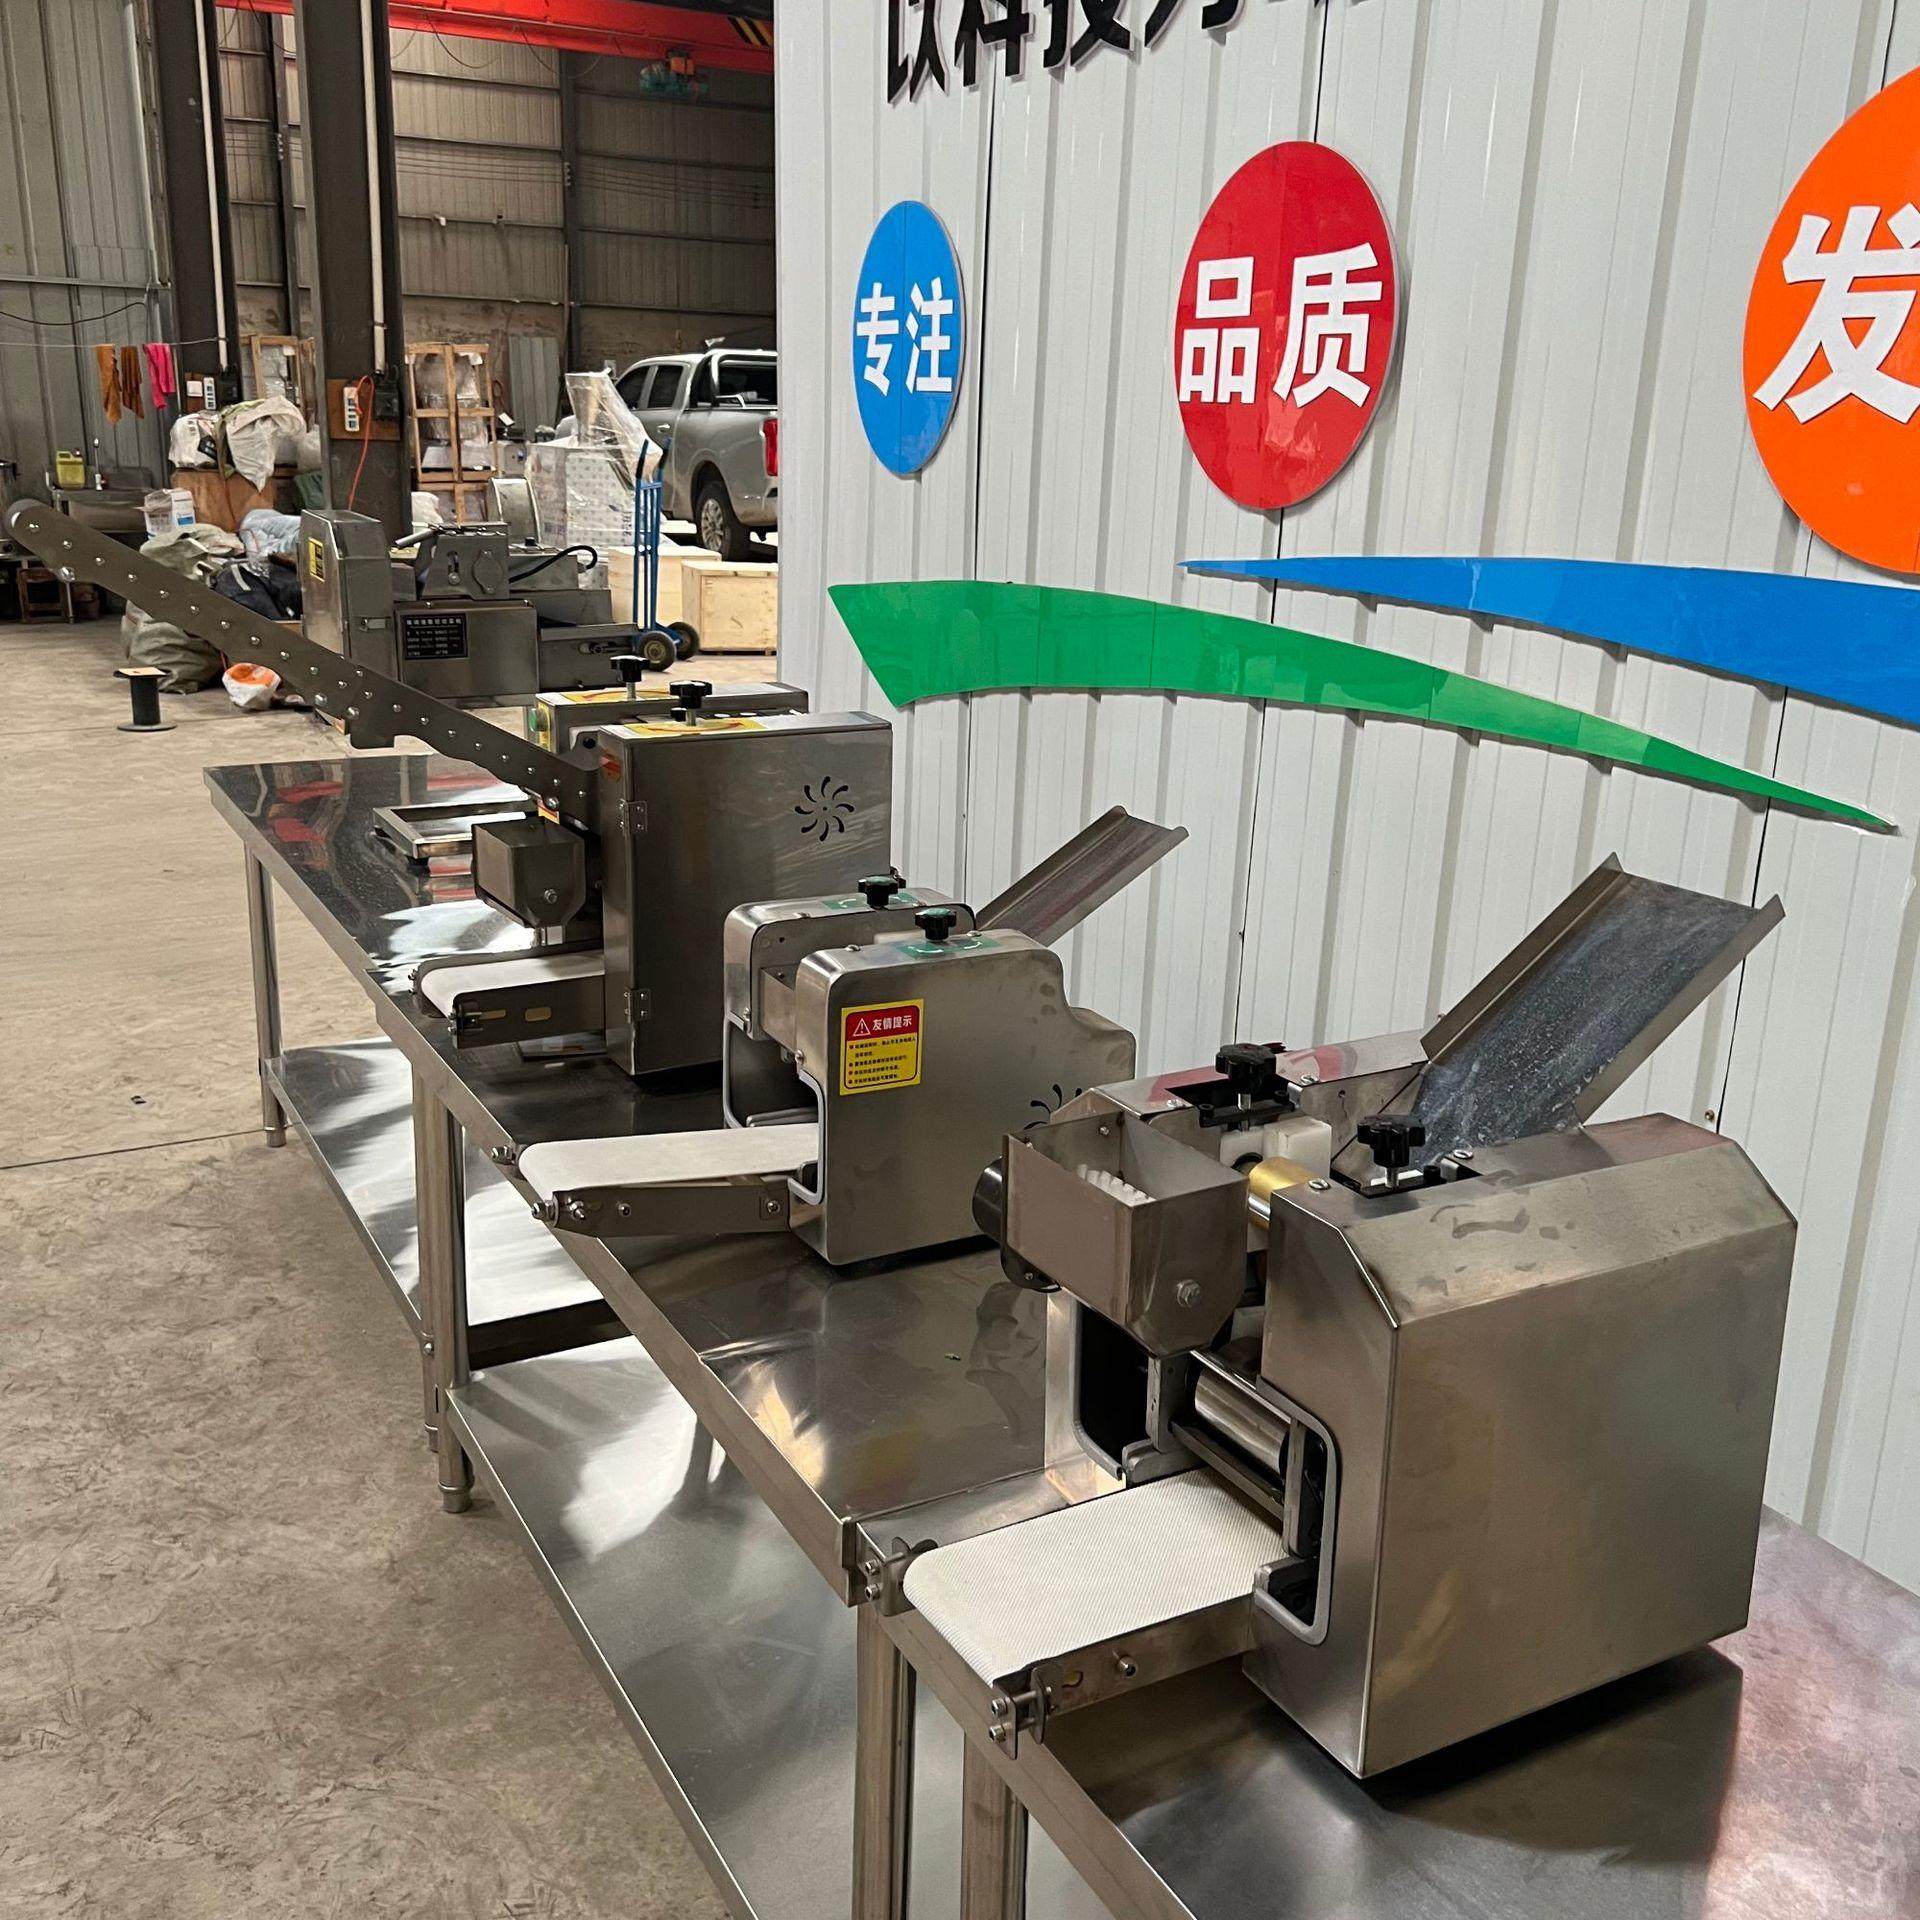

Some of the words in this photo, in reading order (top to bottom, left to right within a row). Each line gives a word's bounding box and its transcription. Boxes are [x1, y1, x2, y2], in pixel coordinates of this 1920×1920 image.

[856, 276, 953, 397] 专注
[1179, 242, 1383, 408] 品质
[1752, 202, 1920, 424] 发
